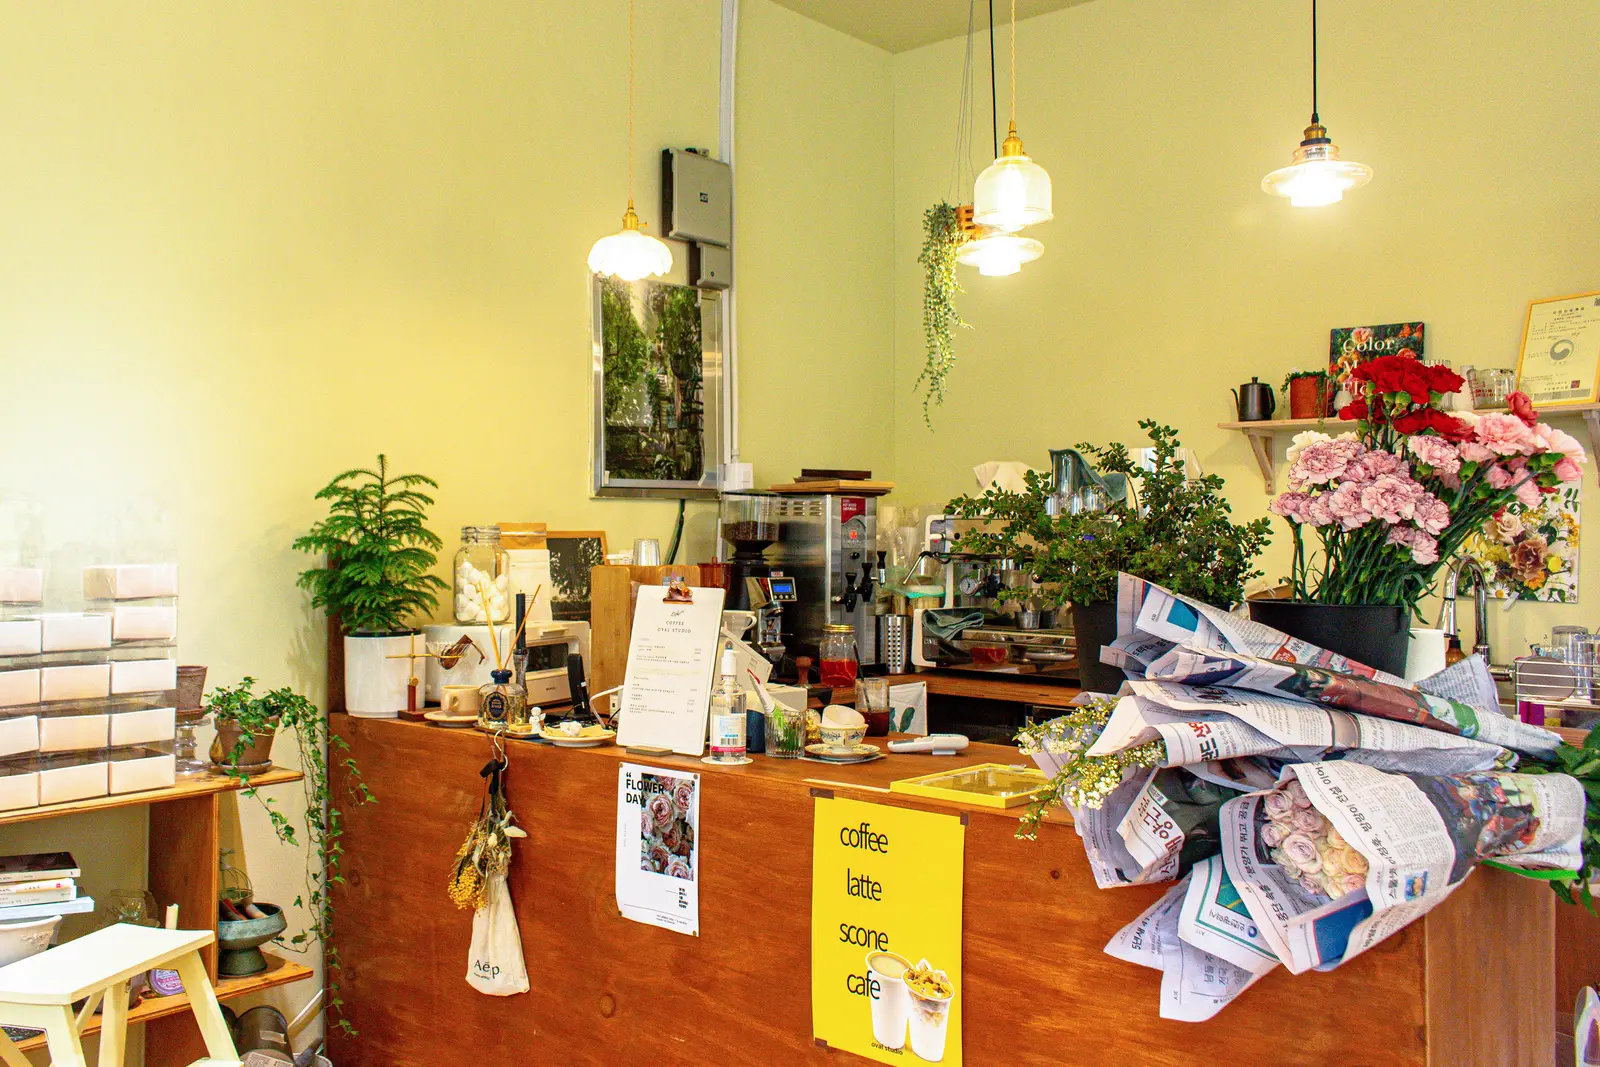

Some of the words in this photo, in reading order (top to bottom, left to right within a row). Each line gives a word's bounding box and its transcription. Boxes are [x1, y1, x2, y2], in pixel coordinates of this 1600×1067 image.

[1343, 336, 1395, 354] Color
[625, 779, 665, 795] FLOWER
[625, 793, 646, 805] DAY
[1346, 802, 1372, 833] 방망이
[840, 822, 889, 854] coffee
[847, 867, 882, 901] latte
[1208, 909, 1246, 931] 인천광역시
[839, 922, 889, 952] scone
[847, 970, 881, 1000] cafe
[871, 1040, 884, 1051] oval
[884, 1043, 903, 1056] studio
